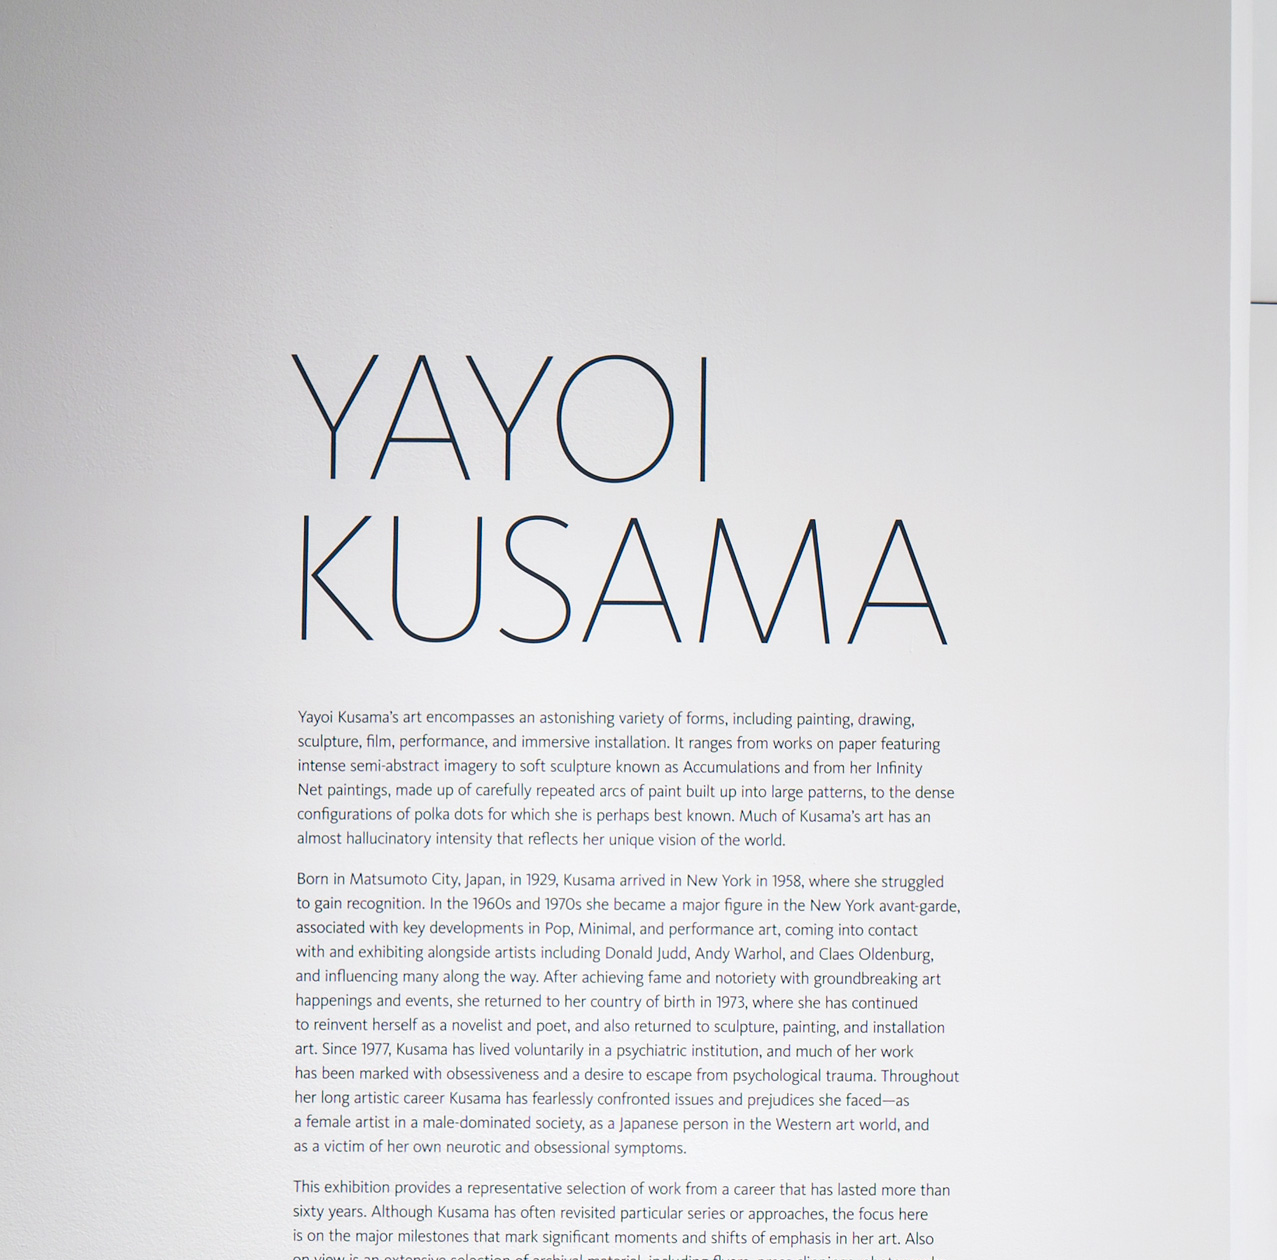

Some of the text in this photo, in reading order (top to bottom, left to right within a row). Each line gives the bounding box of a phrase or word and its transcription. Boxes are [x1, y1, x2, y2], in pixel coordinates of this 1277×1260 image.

[291, 353, 708, 484] YAYOI
[301, 514, 948, 646] KUSAMA
[297, 709, 914, 730] Yayoi Kusama’s art encompasses an astonishing variety of forms, including painting, drawing,
[296, 830, 786, 849] almost hallucinatory intensity that reflects her unique vision of the world.
[296, 871, 944, 892] Born in Matsumoto City, Japan, in 1929, Kusama arrived in New York in 1958, where she struggled
[295, 943, 934, 965] with and exhibiting alongside artists including Donald Judd, Andy Warhol, and Claes Oldenburg,
[294, 1089, 317, 1104] her
[320, 1089, 350, 1108] long
[353, 1090, 399, 1104] artistic
[403, 1094, 445, 1105] career
[449, 1091, 501, 1105] Kusama
[505, 1090, 528, 1105] has
[532, 1090, 594, 1109] fearlessly
[596, 1090, 670, 1106] confronted
[674, 1092, 714, 1106] issues
[718, 1091, 742, 1106] and
[747, 1092, 814, 1110] prejudices
[818, 1092, 842, 1106] she
